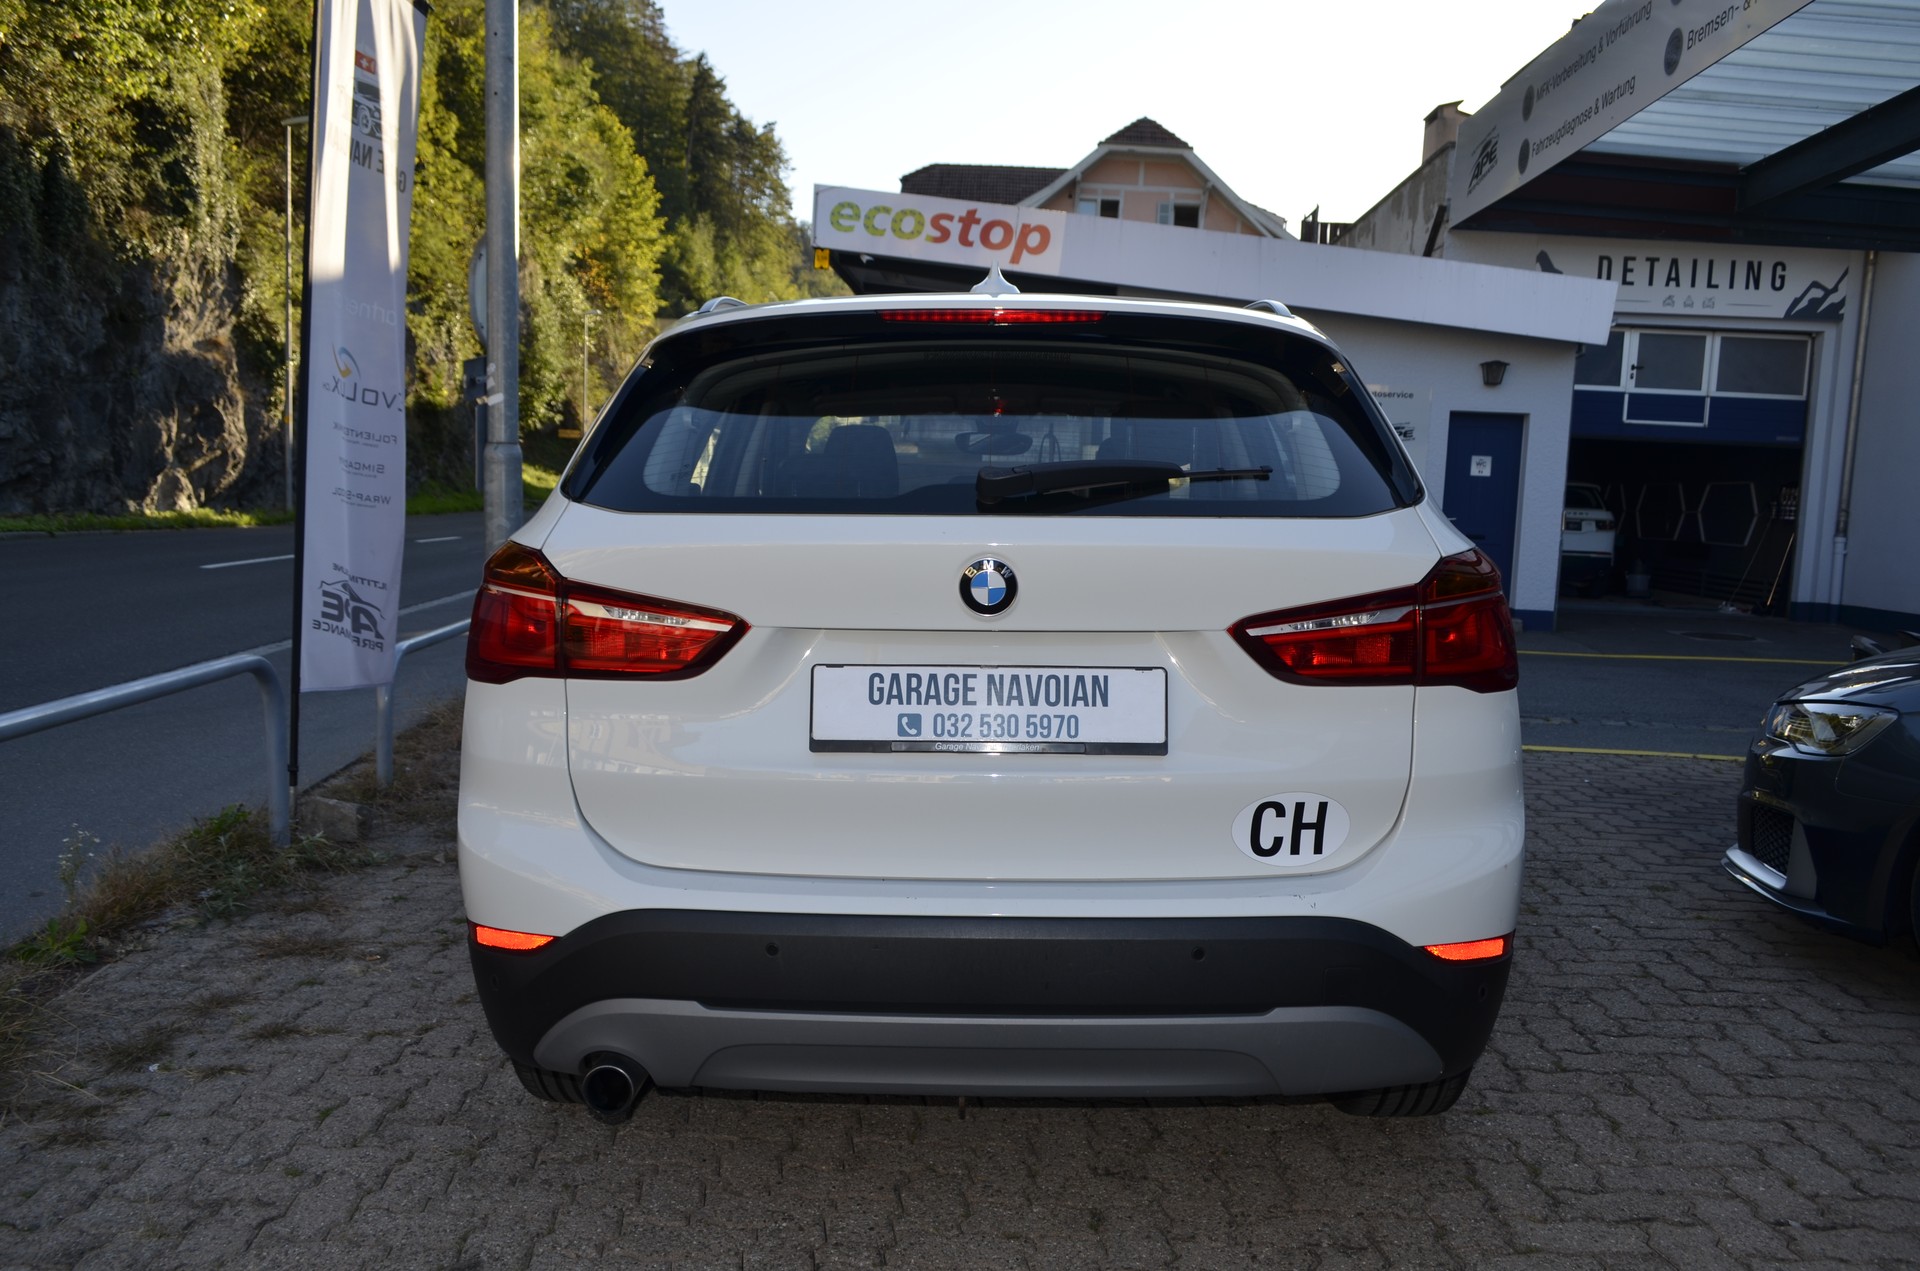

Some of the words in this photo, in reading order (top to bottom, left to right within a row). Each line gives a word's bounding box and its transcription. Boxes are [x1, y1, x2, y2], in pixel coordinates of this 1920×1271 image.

[1687, 5, 1739, 50] Bremsen-
[1536, 45, 1596, 102] MFK-Vorbereitung
[1605, 0, 1652, 47] Vorführung
[1532, 106, 1592, 158] Fahrzeugdiagnose
[1594, 98, 1599, 115] &
[1601, 75, 1636, 110] Wartung
[829, 201, 1052, 265] ecostop
[1597, 255, 1787, 292] DETAILING
[1371, 390, 1414, 400] toservice
[965, 560, 1013, 579] BMW
[868, 672, 978, 706] GARAGE
[986, 673, 1109, 707] NAVOIAN
[933, 713, 973, 738] 032
[979, 714, 1019, 739] 530
[1025, 714, 1080, 739] 5970
[935, 742, 963, 751] Garage
[1250, 801, 1328, 857] CH
